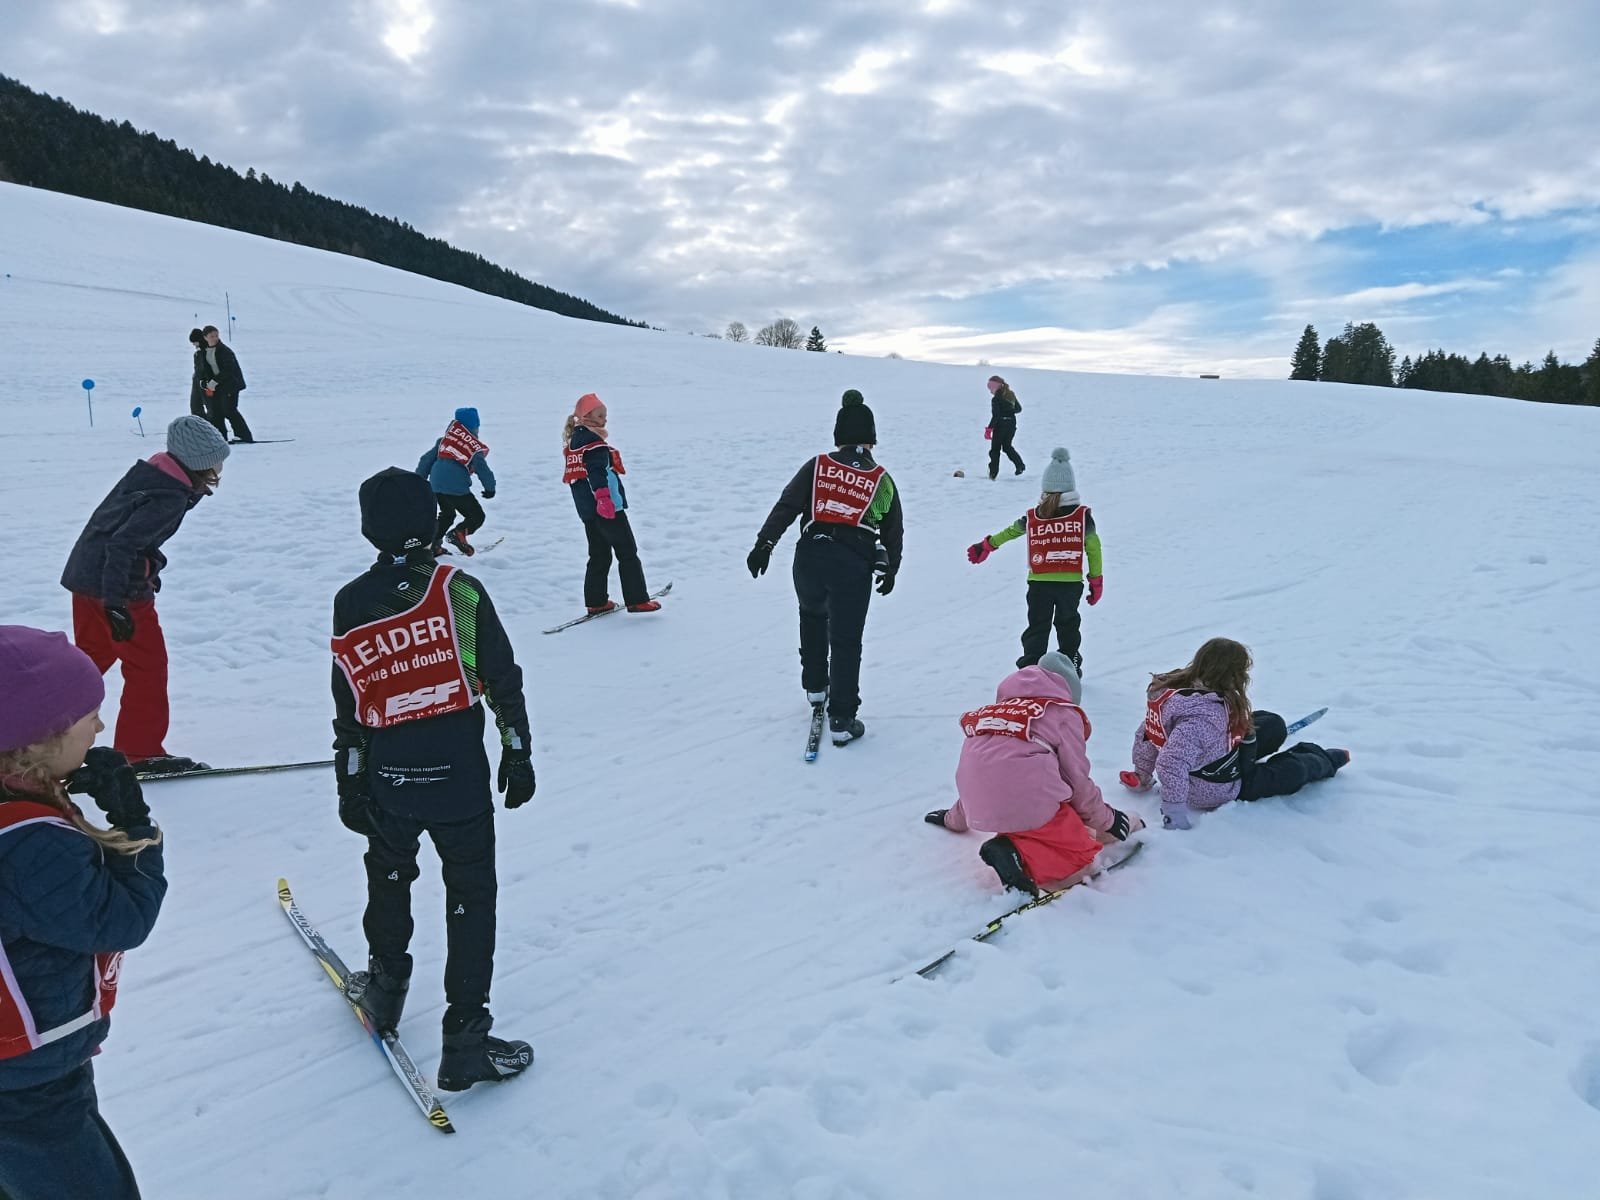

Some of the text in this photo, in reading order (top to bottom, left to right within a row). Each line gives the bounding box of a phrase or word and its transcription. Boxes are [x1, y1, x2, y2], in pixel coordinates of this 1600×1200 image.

[449, 425, 482, 452] LEADER
[817, 480, 837, 492] Coupe
[837, 485, 847, 494] du
[818, 465, 875, 493] LEADER
[1030, 521, 1082, 537] LEADER
[1052, 536, 1061, 544] du
[342, 616, 449, 676] LEADER
[391, 658, 409, 675] du
[412, 648, 454, 669] doubs
[385, 679, 461, 718] ESF
